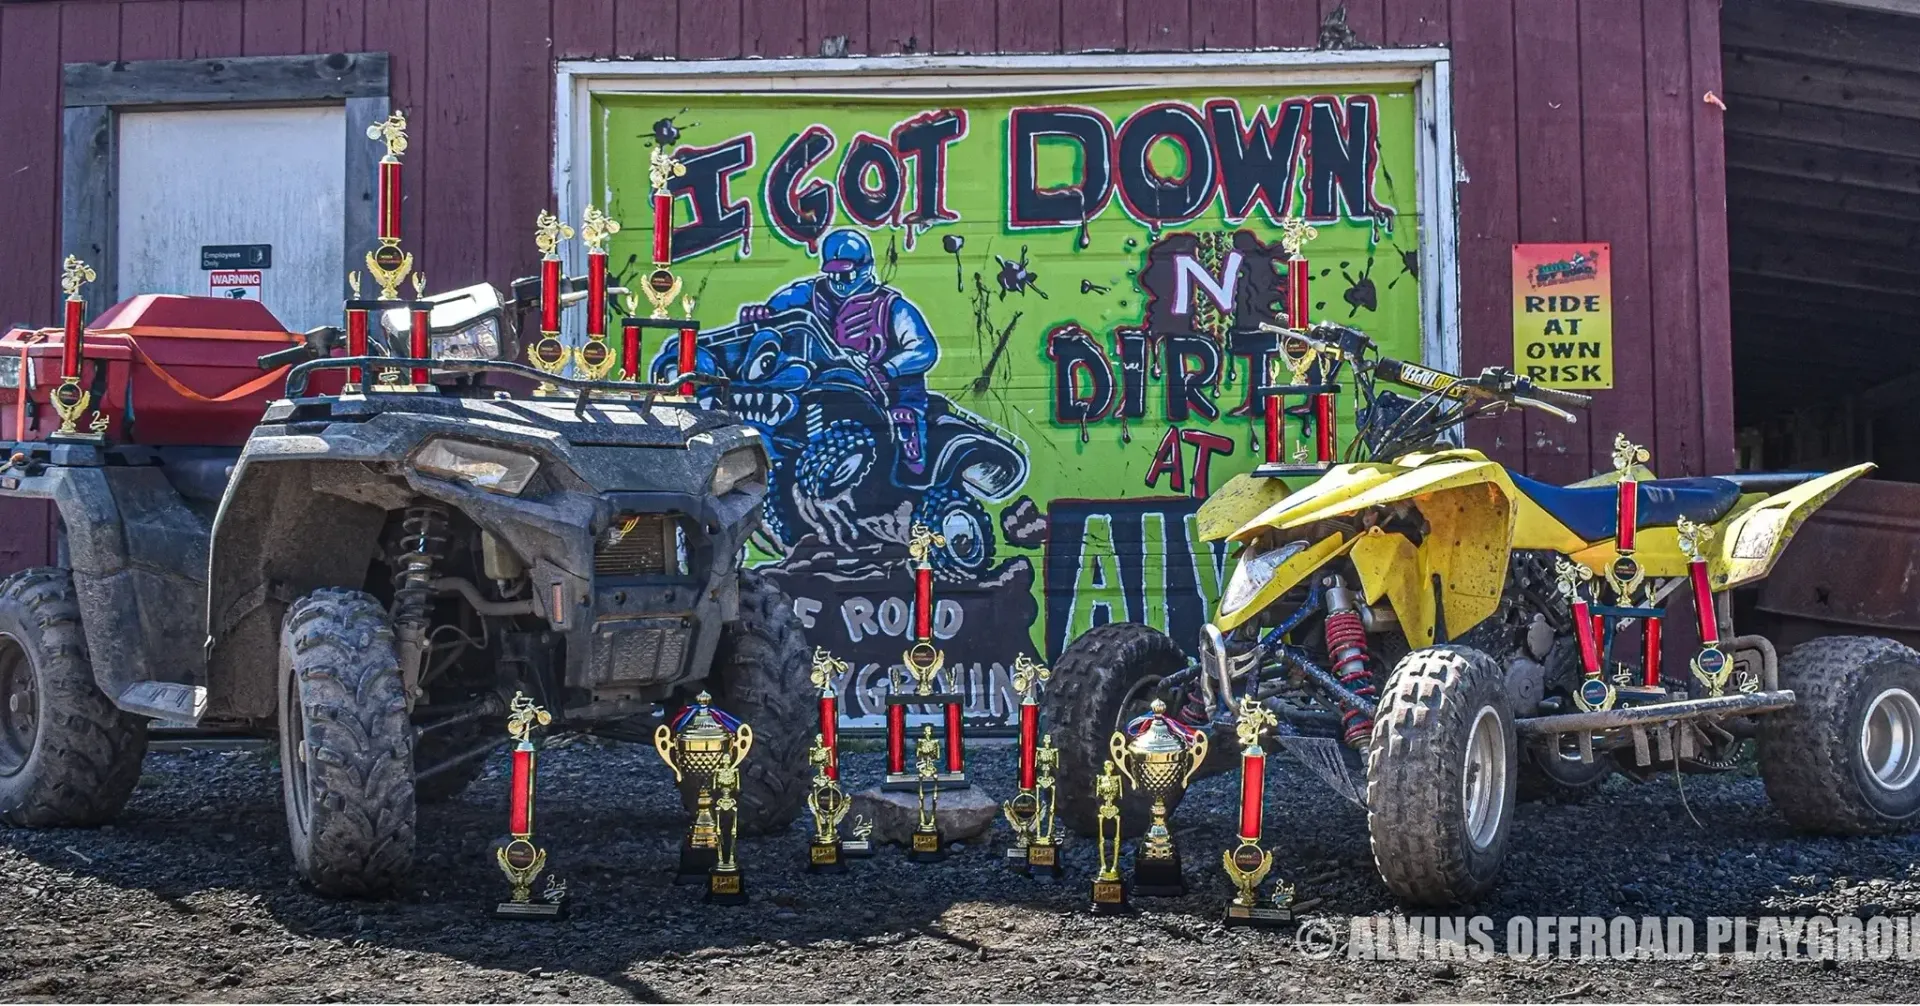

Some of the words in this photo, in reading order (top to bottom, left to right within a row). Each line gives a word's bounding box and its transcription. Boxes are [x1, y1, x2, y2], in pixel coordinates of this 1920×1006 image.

[650, 132, 756, 262] I
[765, 108, 969, 254] GOT
[1009, 96, 1395, 240] DOWN
[203, 252, 241, 260] Employees
[203, 260, 220, 268] Only
[212, 274, 261, 286] WARNING
[1172, 251, 1243, 315] N
[1525, 295, 1600, 313] RIDE
[1543, 318, 1583, 336] AT
[1526, 342, 1600, 360] OWN
[1527, 365, 1602, 383] RISK
[1145, 425, 1235, 499] AT
